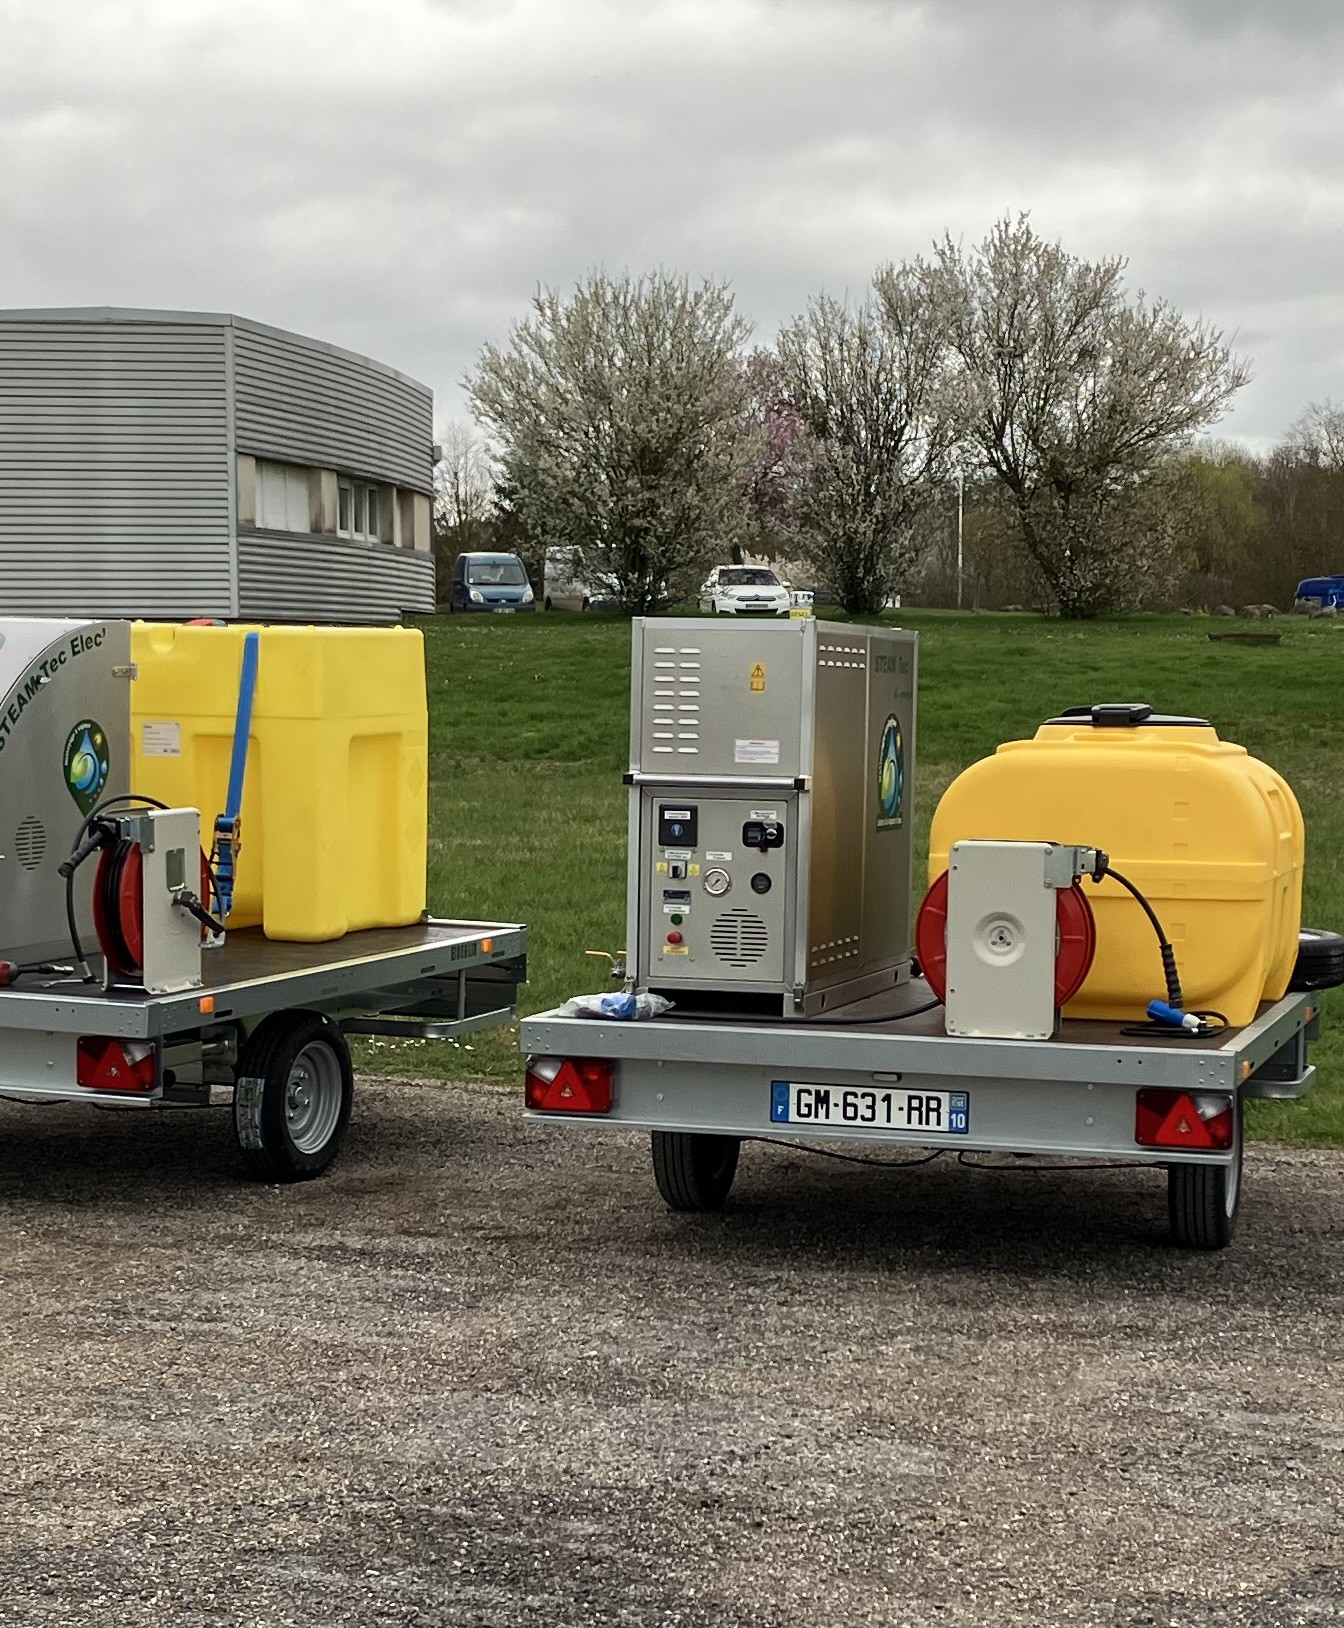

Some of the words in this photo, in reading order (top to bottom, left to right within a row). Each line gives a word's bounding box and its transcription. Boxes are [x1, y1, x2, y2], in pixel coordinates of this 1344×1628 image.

[39, 650, 68, 680] Tec
[70, 627, 107, 657] Elec'
[777, 1105, 785, 1115] F
[795, 1088, 942, 1127] GM-631-RR
[950, 1113, 966, 1129] 10
